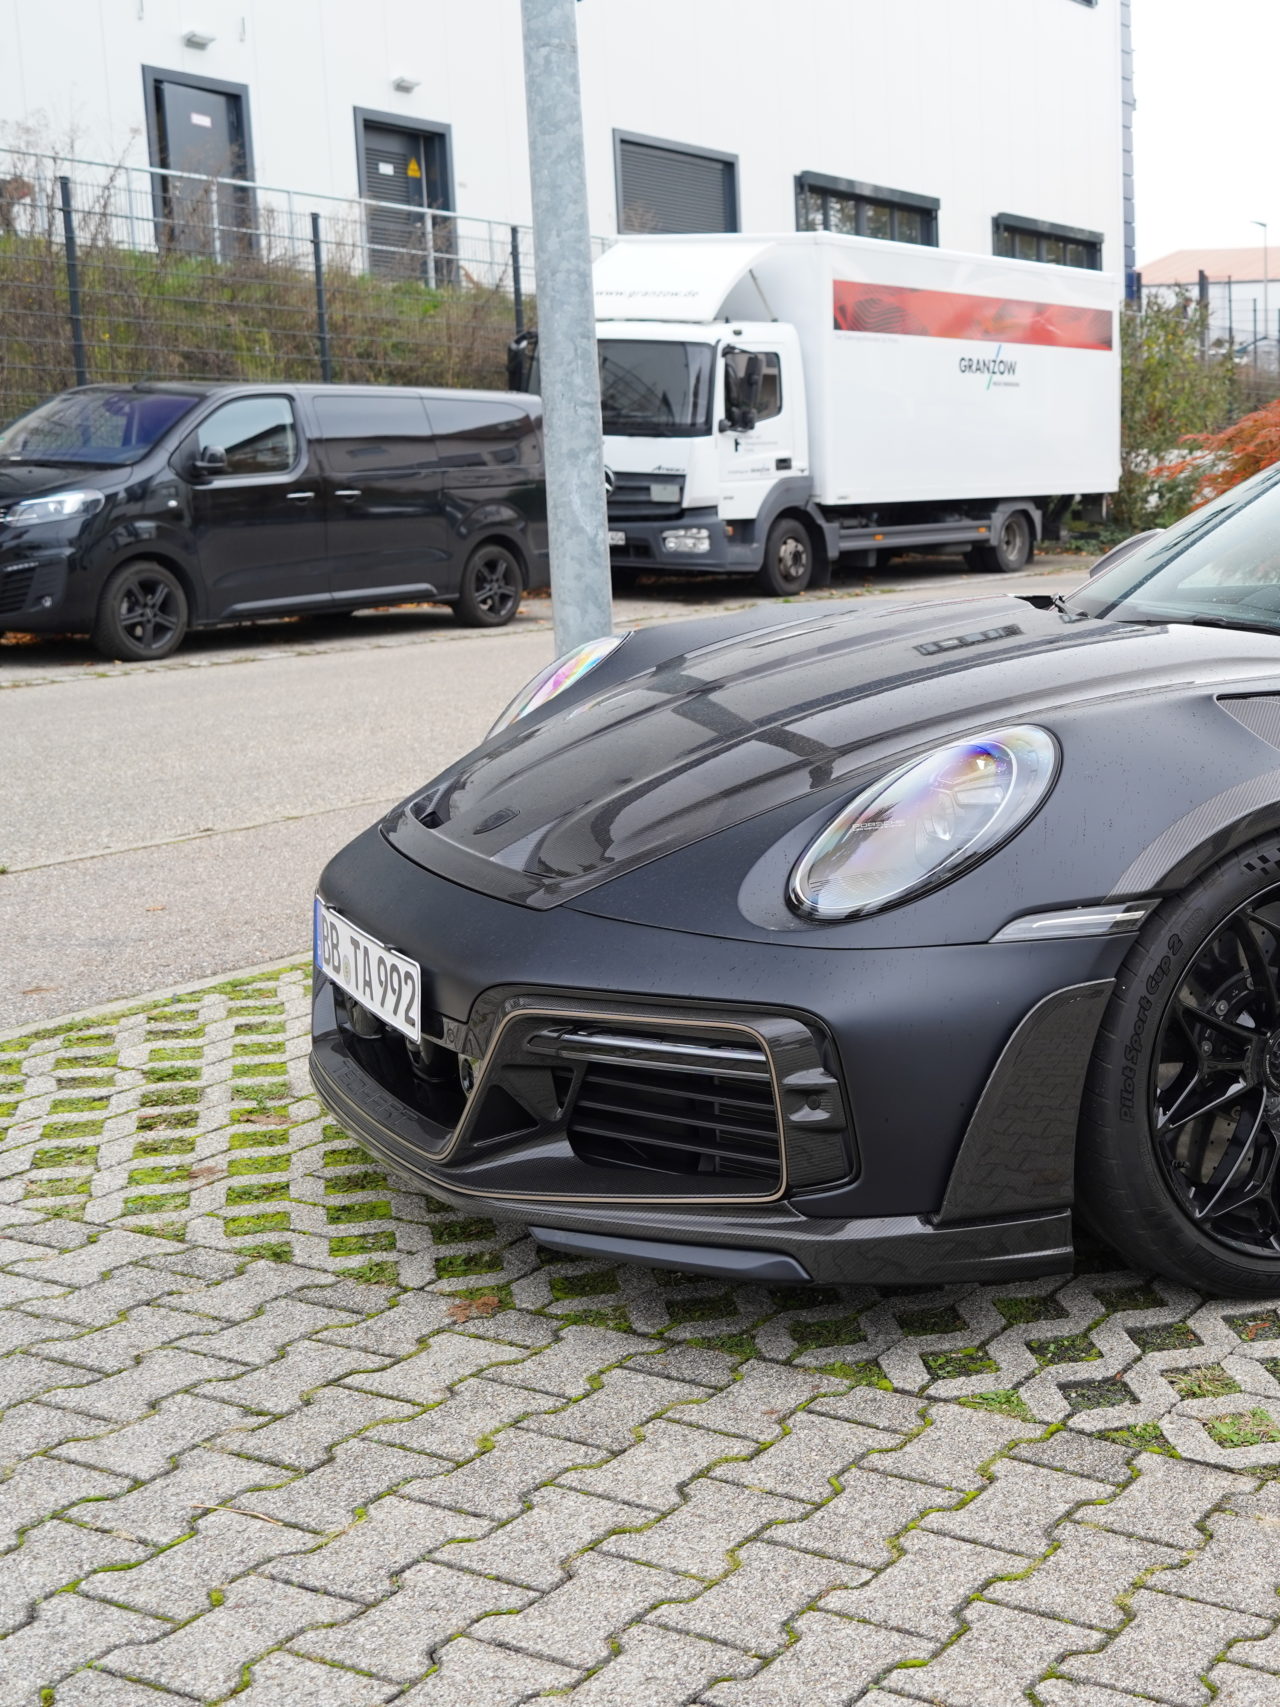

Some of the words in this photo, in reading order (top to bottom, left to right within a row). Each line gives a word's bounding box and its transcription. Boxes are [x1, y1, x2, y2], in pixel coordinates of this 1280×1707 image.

[959, 357, 1017, 376] GRANZOW
[322, 913, 341, 975] BB
[350, 936, 374, 1002] TA
[377, 955, 417, 1029] 992
[1168, 933, 1184, 956] 2
[1146, 955, 1171, 995] Cup
[1124, 996, 1152, 1065] Sport
[332, 1059, 419, 1127] TECHART
[1120, 1066, 1137, 1123] Pilot
